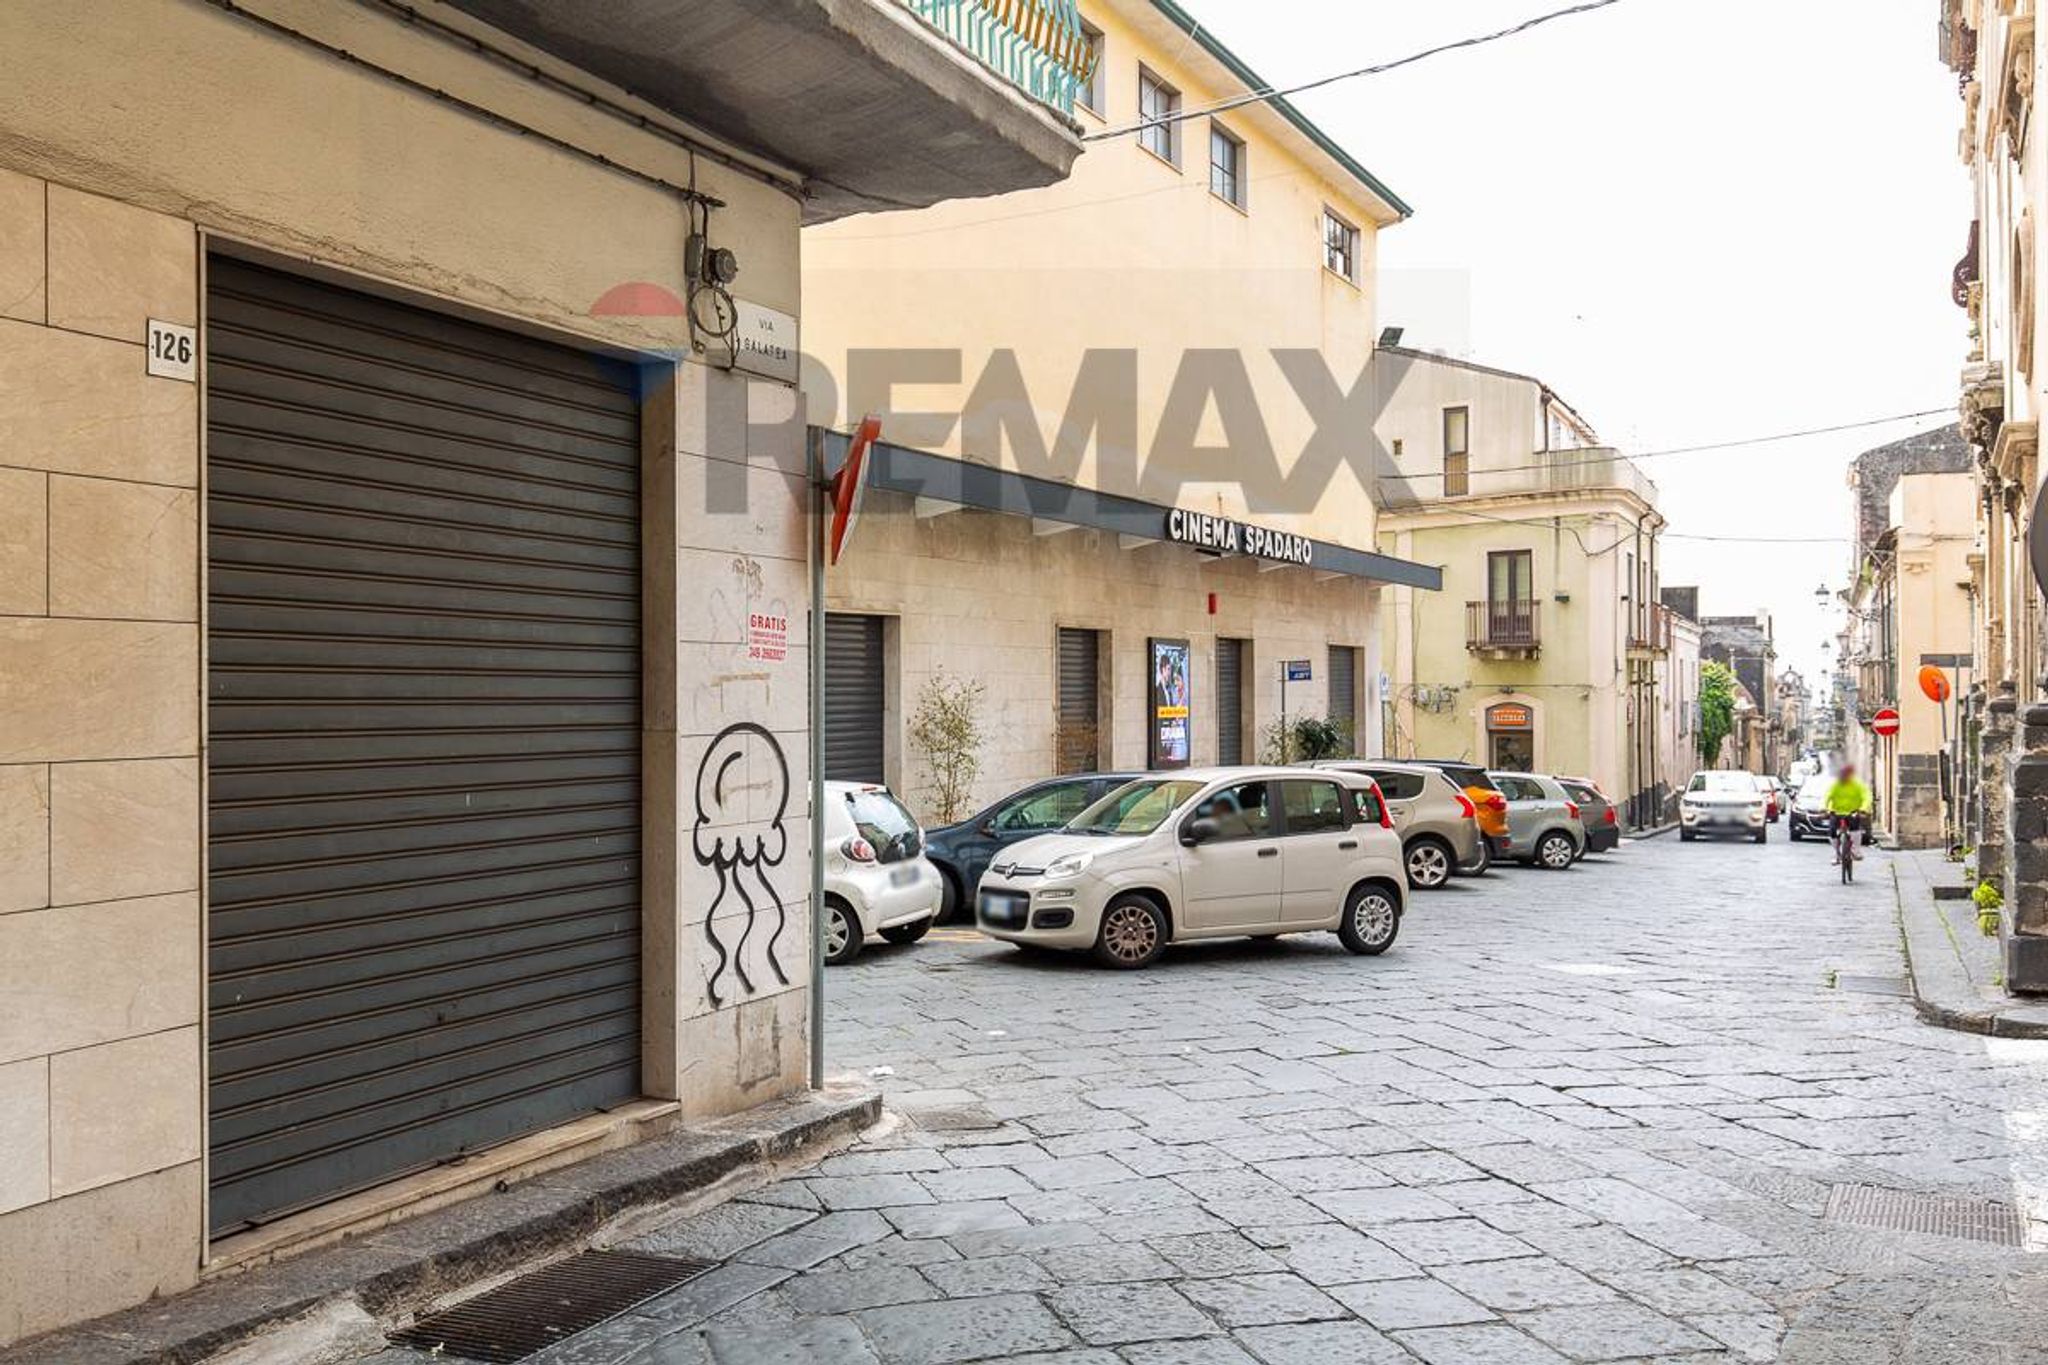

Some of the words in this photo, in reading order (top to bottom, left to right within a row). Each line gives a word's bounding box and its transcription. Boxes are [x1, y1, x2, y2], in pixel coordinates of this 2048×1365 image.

[759, 319, 774, 332] VIA
[153, 330, 190, 364] 126
[1169, 509, 1237, 551] CINEMA
[1245, 526, 1312, 563] SPADARO
[750, 614, 786, 631] GRATIS
